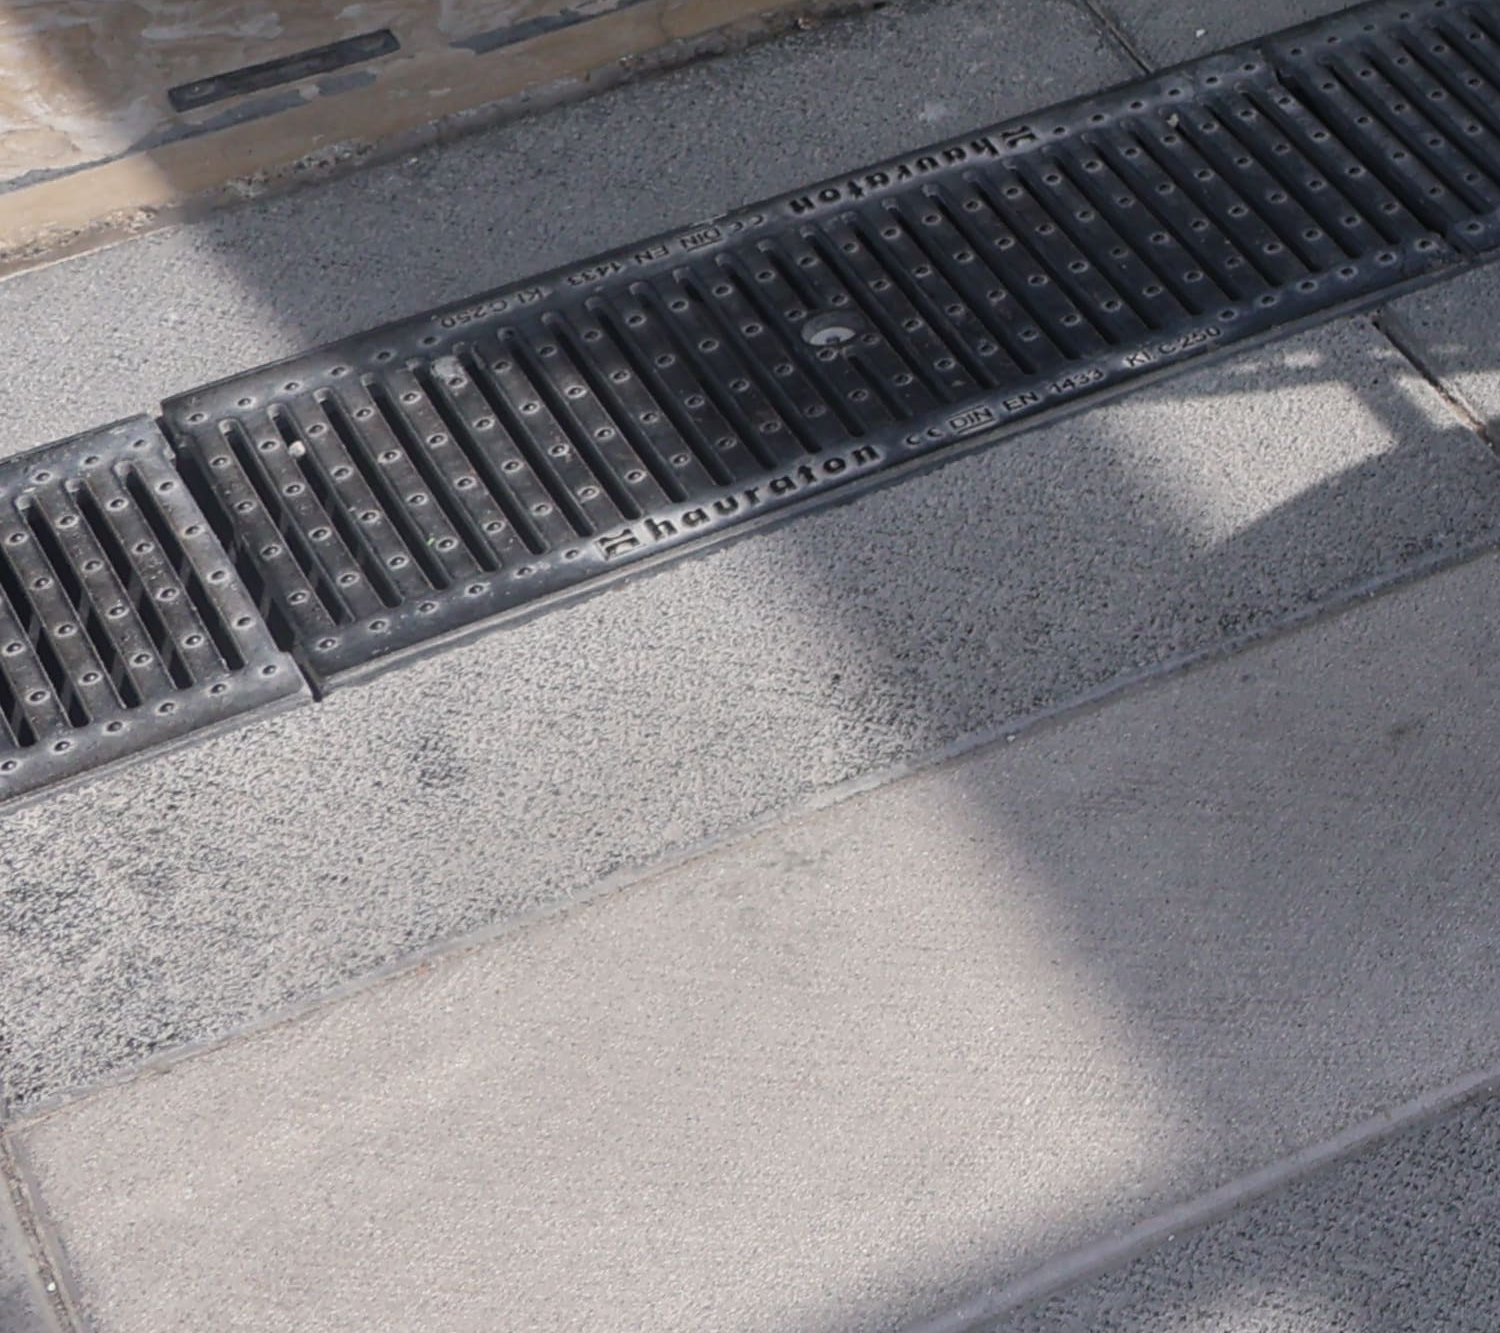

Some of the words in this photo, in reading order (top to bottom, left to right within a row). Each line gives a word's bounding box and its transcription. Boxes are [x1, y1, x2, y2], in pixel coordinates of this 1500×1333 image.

[788, 137, 999, 214] hauraton
[634, 244, 670, 265] EN
[644, 444, 881, 541] hauraton
[949, 405, 994, 432] DIN
[1002, 391, 1039, 412] EN
